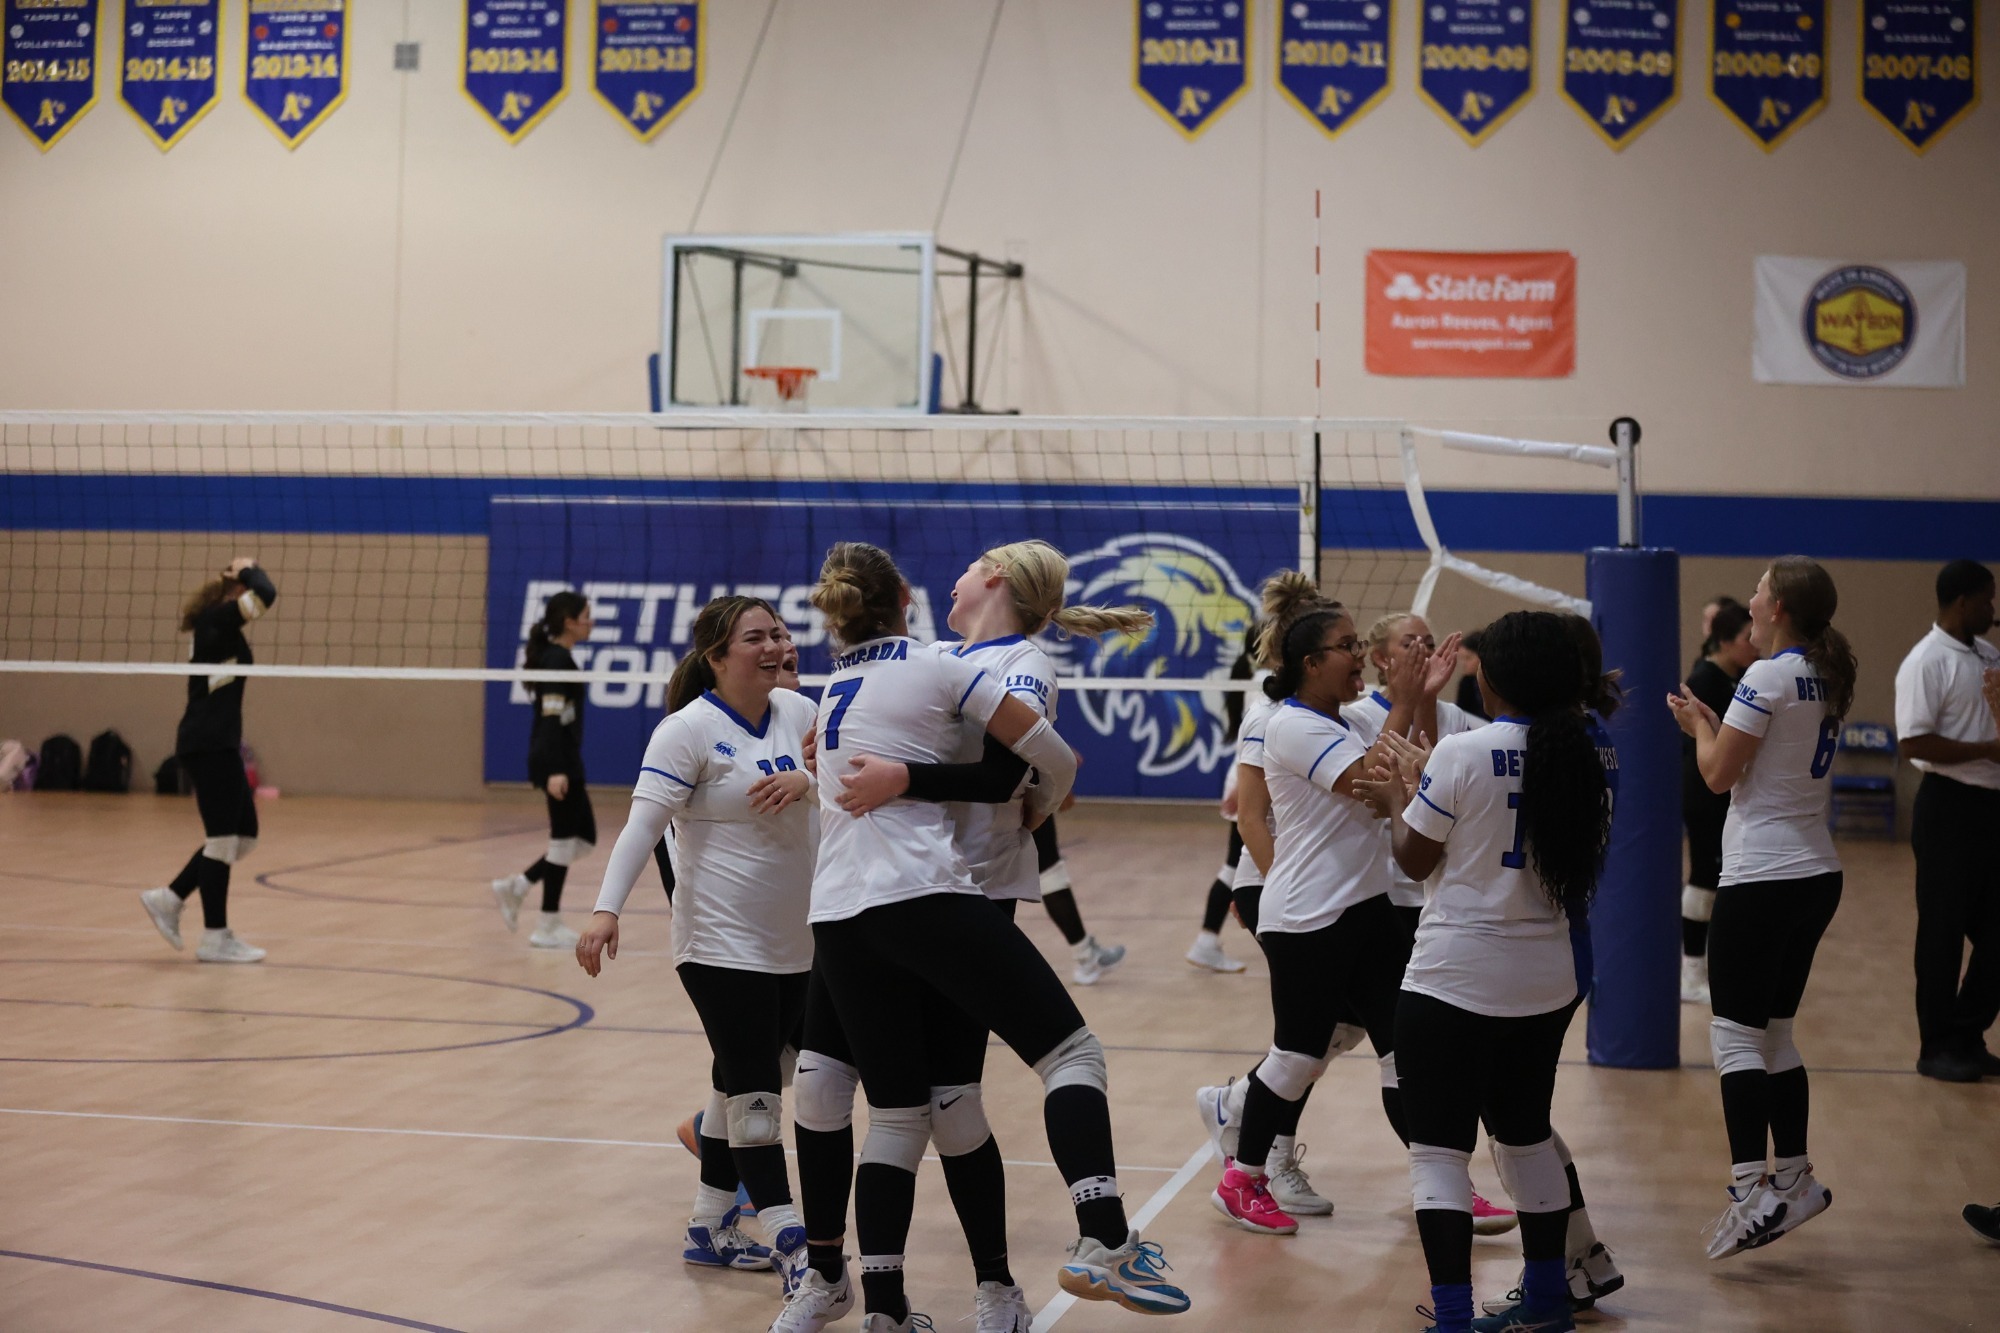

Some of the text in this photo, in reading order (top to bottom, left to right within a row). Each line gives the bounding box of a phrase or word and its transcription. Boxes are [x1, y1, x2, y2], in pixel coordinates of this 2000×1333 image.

[1142, 38, 1240, 66] 2010-11
[1284, 40, 1386, 68] 2010-11
[6, 58, 90, 82] 2014-15
[125, 57, 213, 81] 2014-15
[251, 54, 339, 80] 2013-14
[1005, 674, 1049, 699] LIONS
[825, 676, 864, 751] 7
[1810, 715, 1840, 780] 6
[1843, 728, 1889, 748] BCS
